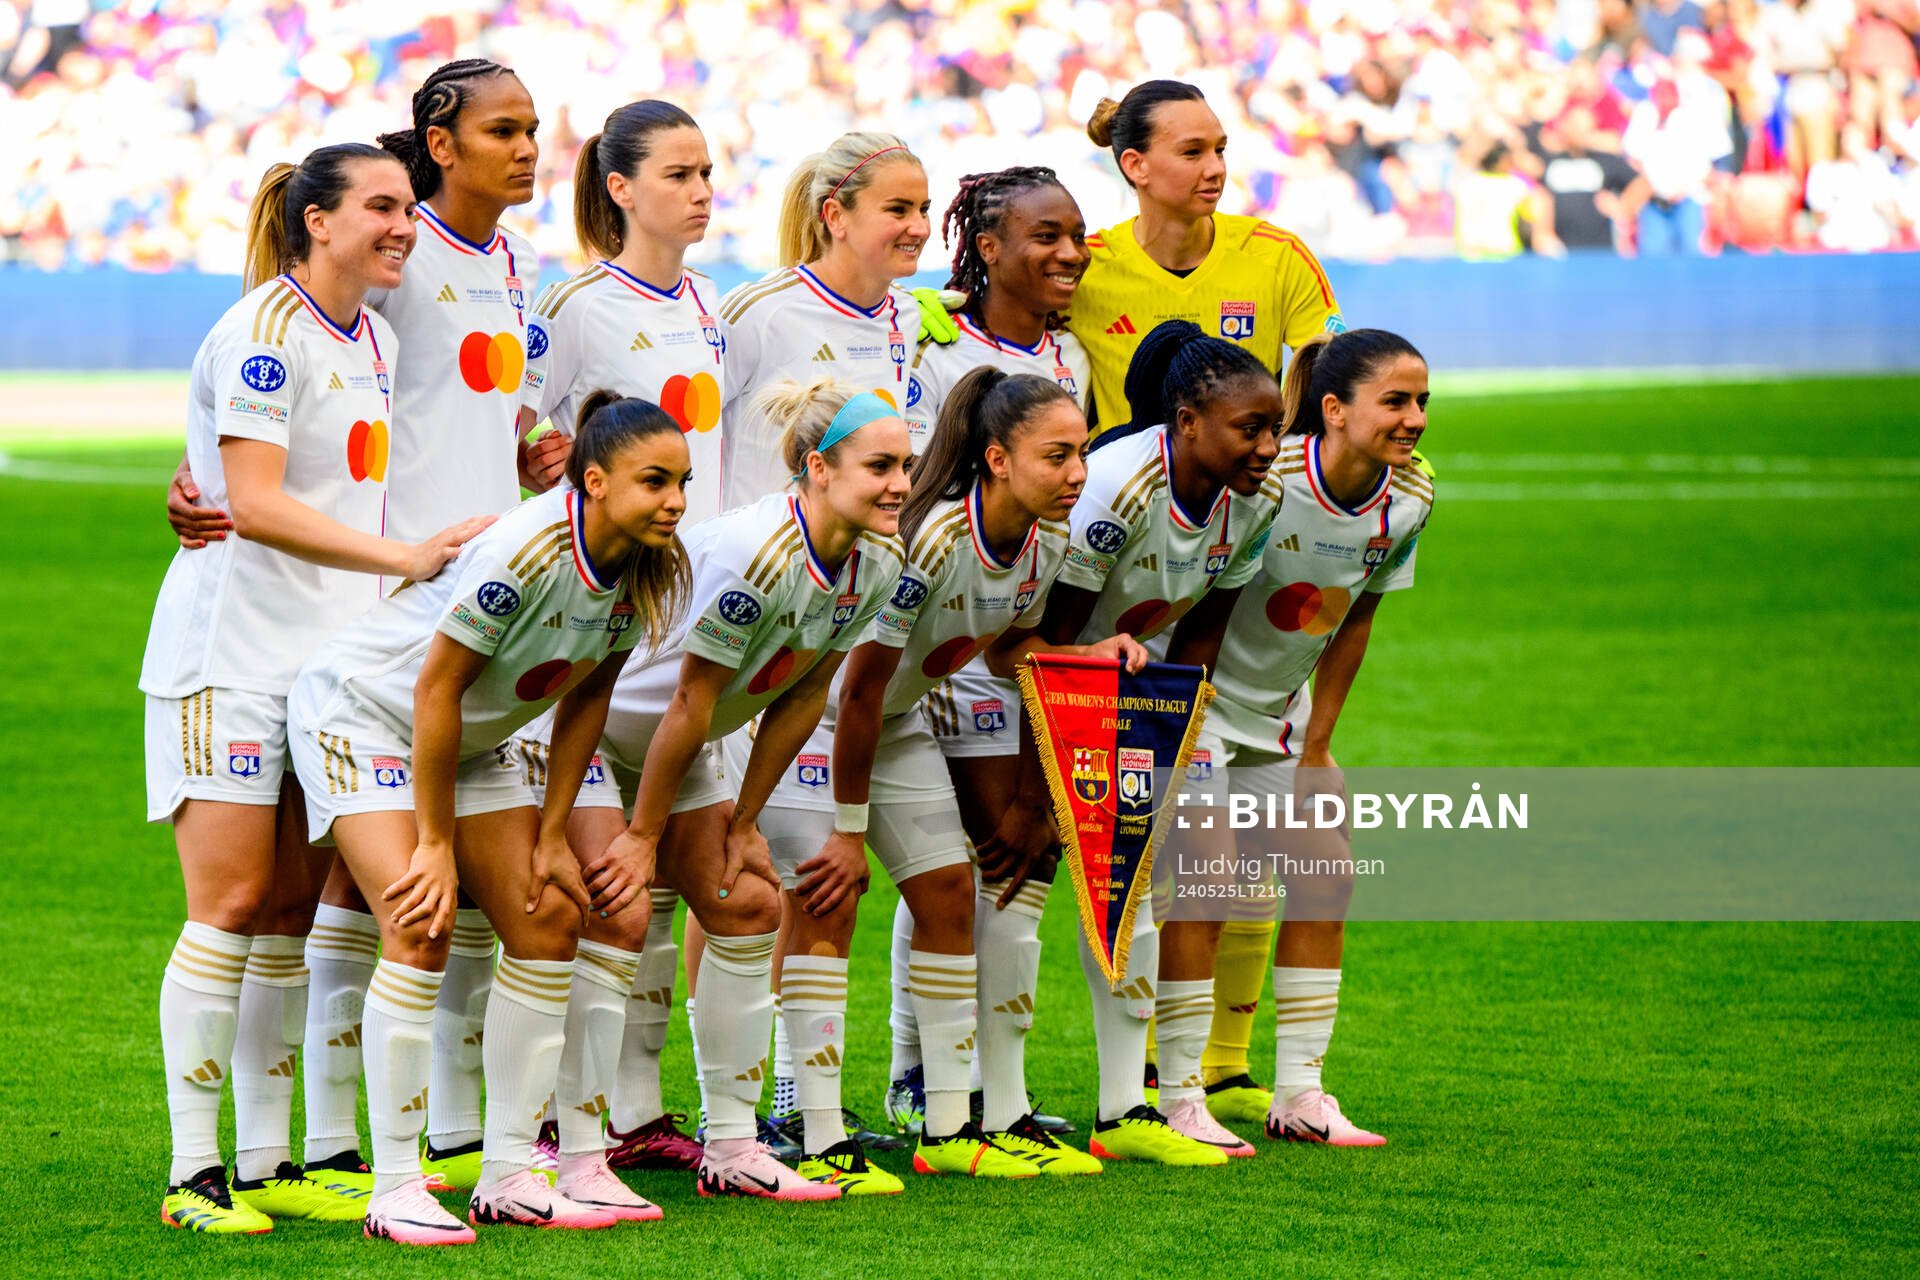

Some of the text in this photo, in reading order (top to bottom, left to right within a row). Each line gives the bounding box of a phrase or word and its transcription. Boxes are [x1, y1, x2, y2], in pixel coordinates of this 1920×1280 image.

[1222, 316, 1252, 336] OL
[259, 364, 270, 380] 8
[229, 400, 288, 418] FOUNDATION
[1102, 531, 1114, 543] 8
[1207, 556, 1226, 571] OL
[1365, 549, 1385, 563] OL
[494, 591, 507, 606] 8
[903, 587, 914, 599] 8
[735, 602, 748, 615] 8
[835, 606, 854, 621] OL
[609, 615, 630, 630] OL
[1045, 691, 1188, 714] UEFA WOMEN'S CHAMPIONS LEAGUE
[977, 712, 1004, 729] OL
[1101, 717, 1132, 730] FINALE
[1121, 751, 1152, 761] OLYMPIQUE
[231, 756, 258, 773] OL
[1121, 760, 1152, 769] LYONNAIS
[377, 769, 404, 786] OL
[800, 766, 827, 784] OL
[1122, 771, 1151, 799] OL
[1120, 825, 1147, 836] LYONNAIS
[822, 1020, 835, 1036] 4
